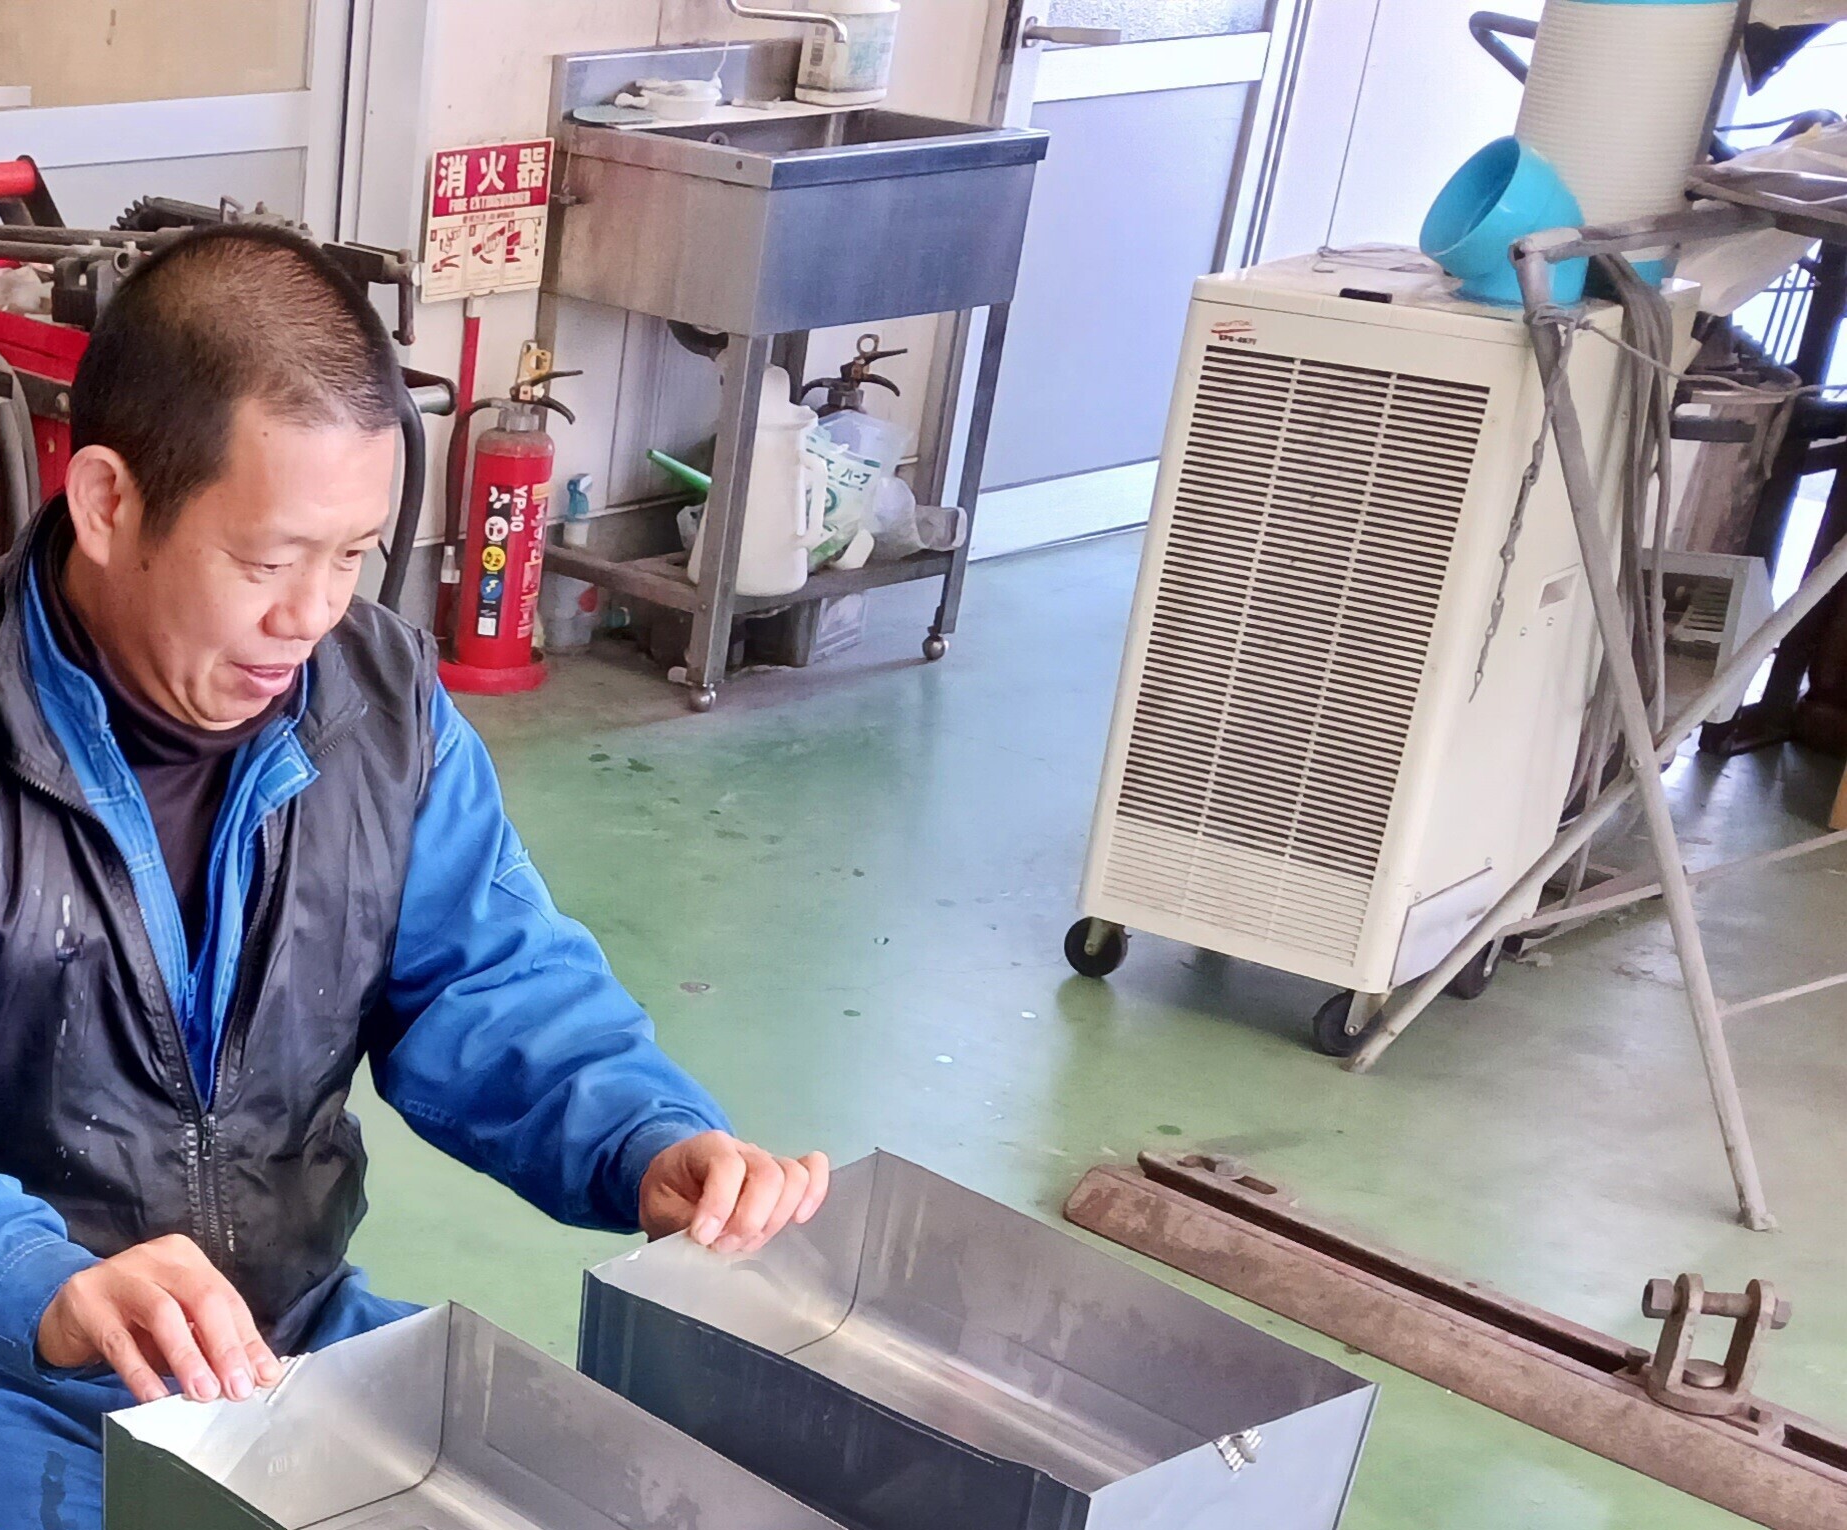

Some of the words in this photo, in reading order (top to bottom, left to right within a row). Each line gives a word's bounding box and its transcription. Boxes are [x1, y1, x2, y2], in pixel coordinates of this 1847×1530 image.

[437, 147, 547, 197] 消火器
[509, 484, 529, 533] YP-10
